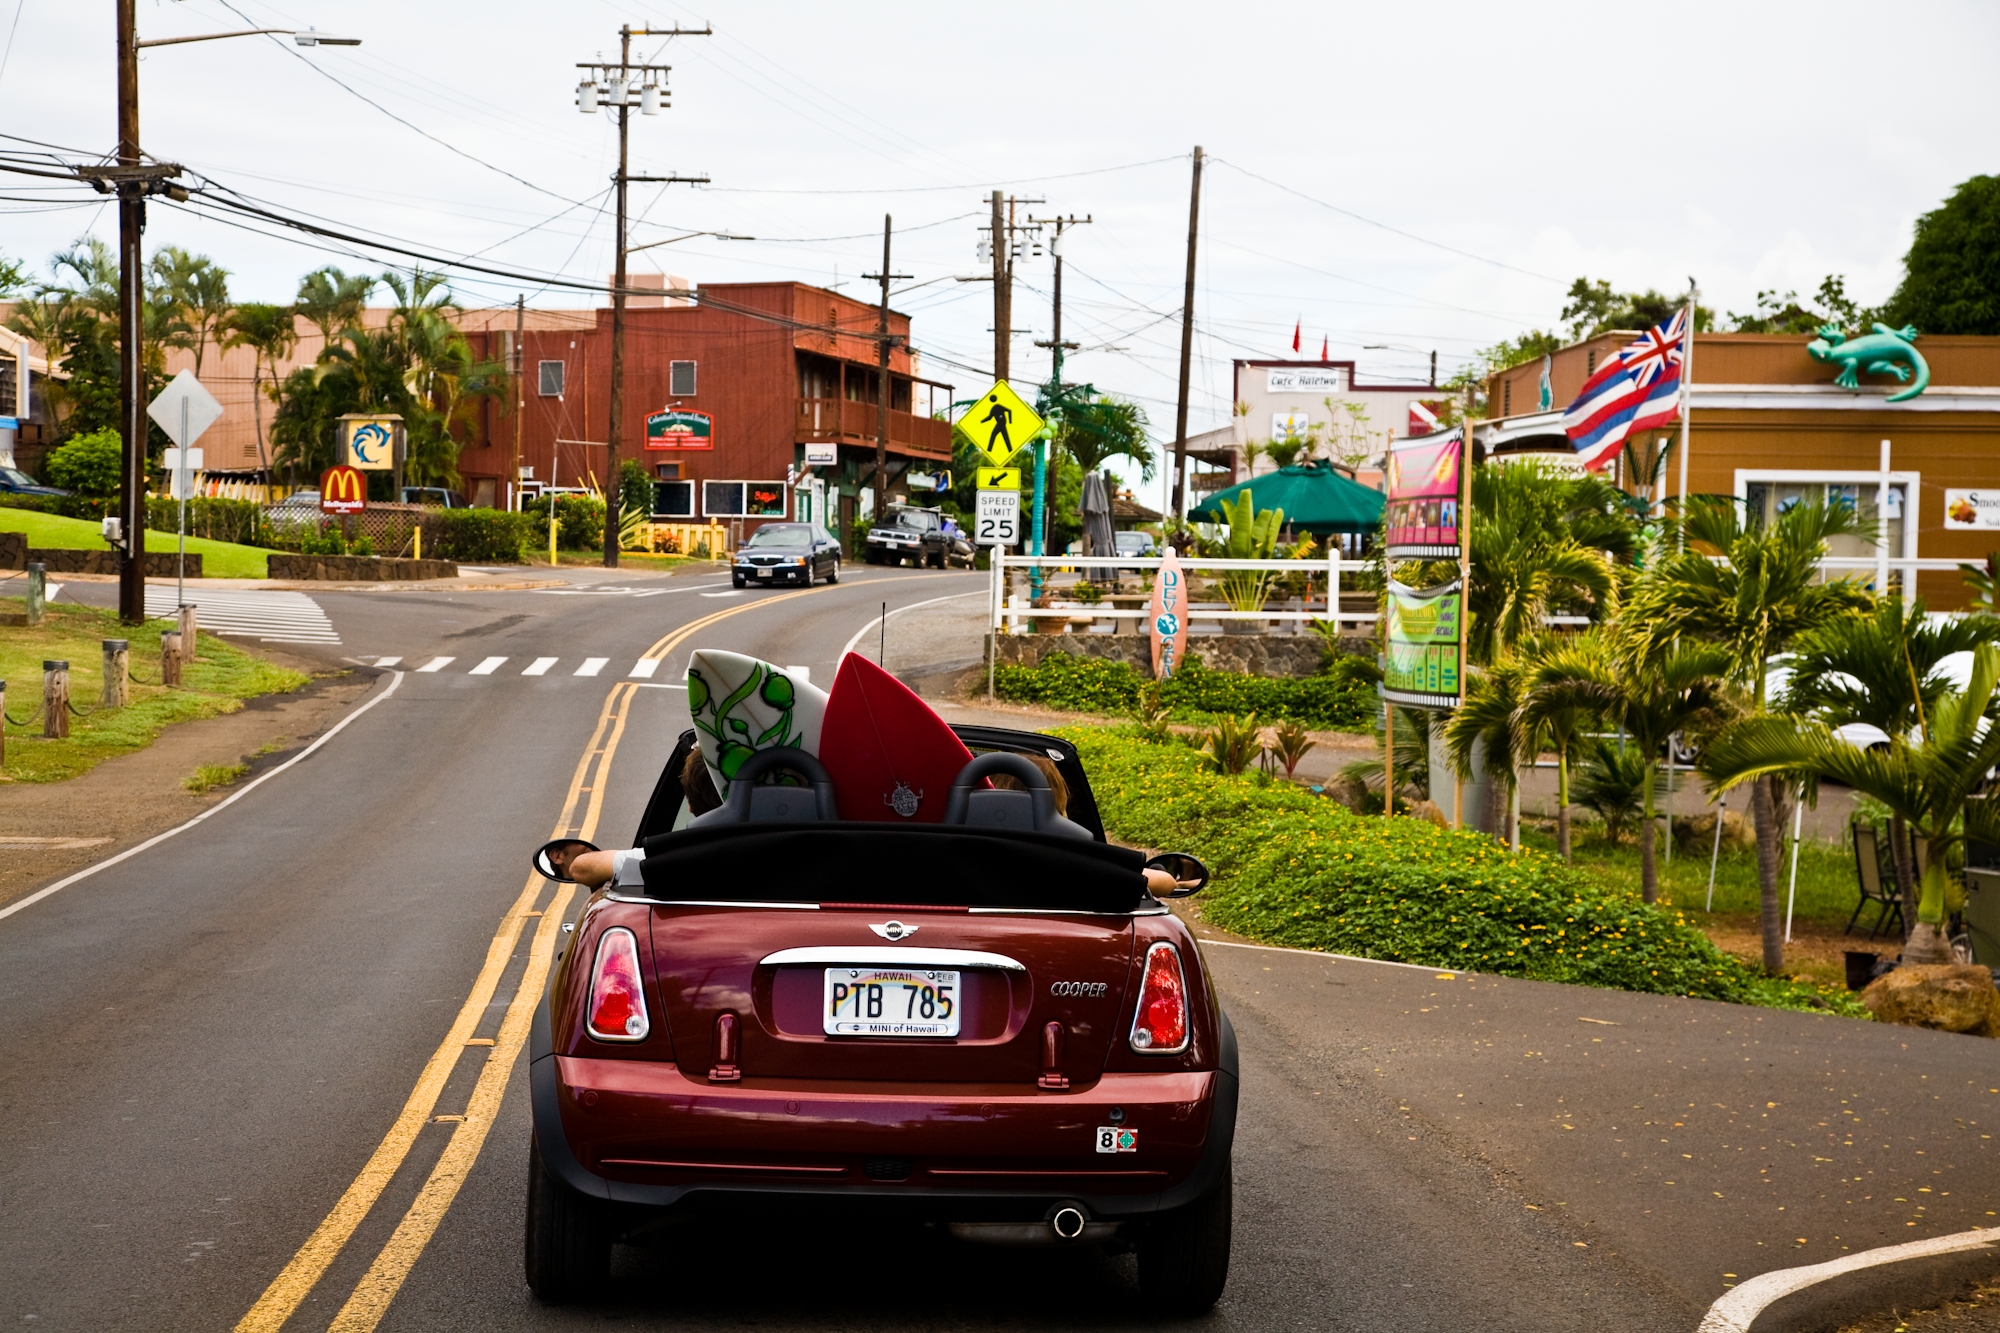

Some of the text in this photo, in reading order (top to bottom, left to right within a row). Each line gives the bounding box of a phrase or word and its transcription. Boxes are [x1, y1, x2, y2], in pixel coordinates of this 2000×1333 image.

[981, 497, 1016, 506] SPEED
[983, 508, 1012, 516] LIMIT
[980, 519, 1014, 539] 25
[874, 972, 912, 981] HAWAII
[1050, 981, 1108, 998] COOPER
[832, 983, 953, 1020] PTB 785
[869, 1024, 938, 1033] MINI of Hawaii
[1101, 1132, 1113, 1148] 8
